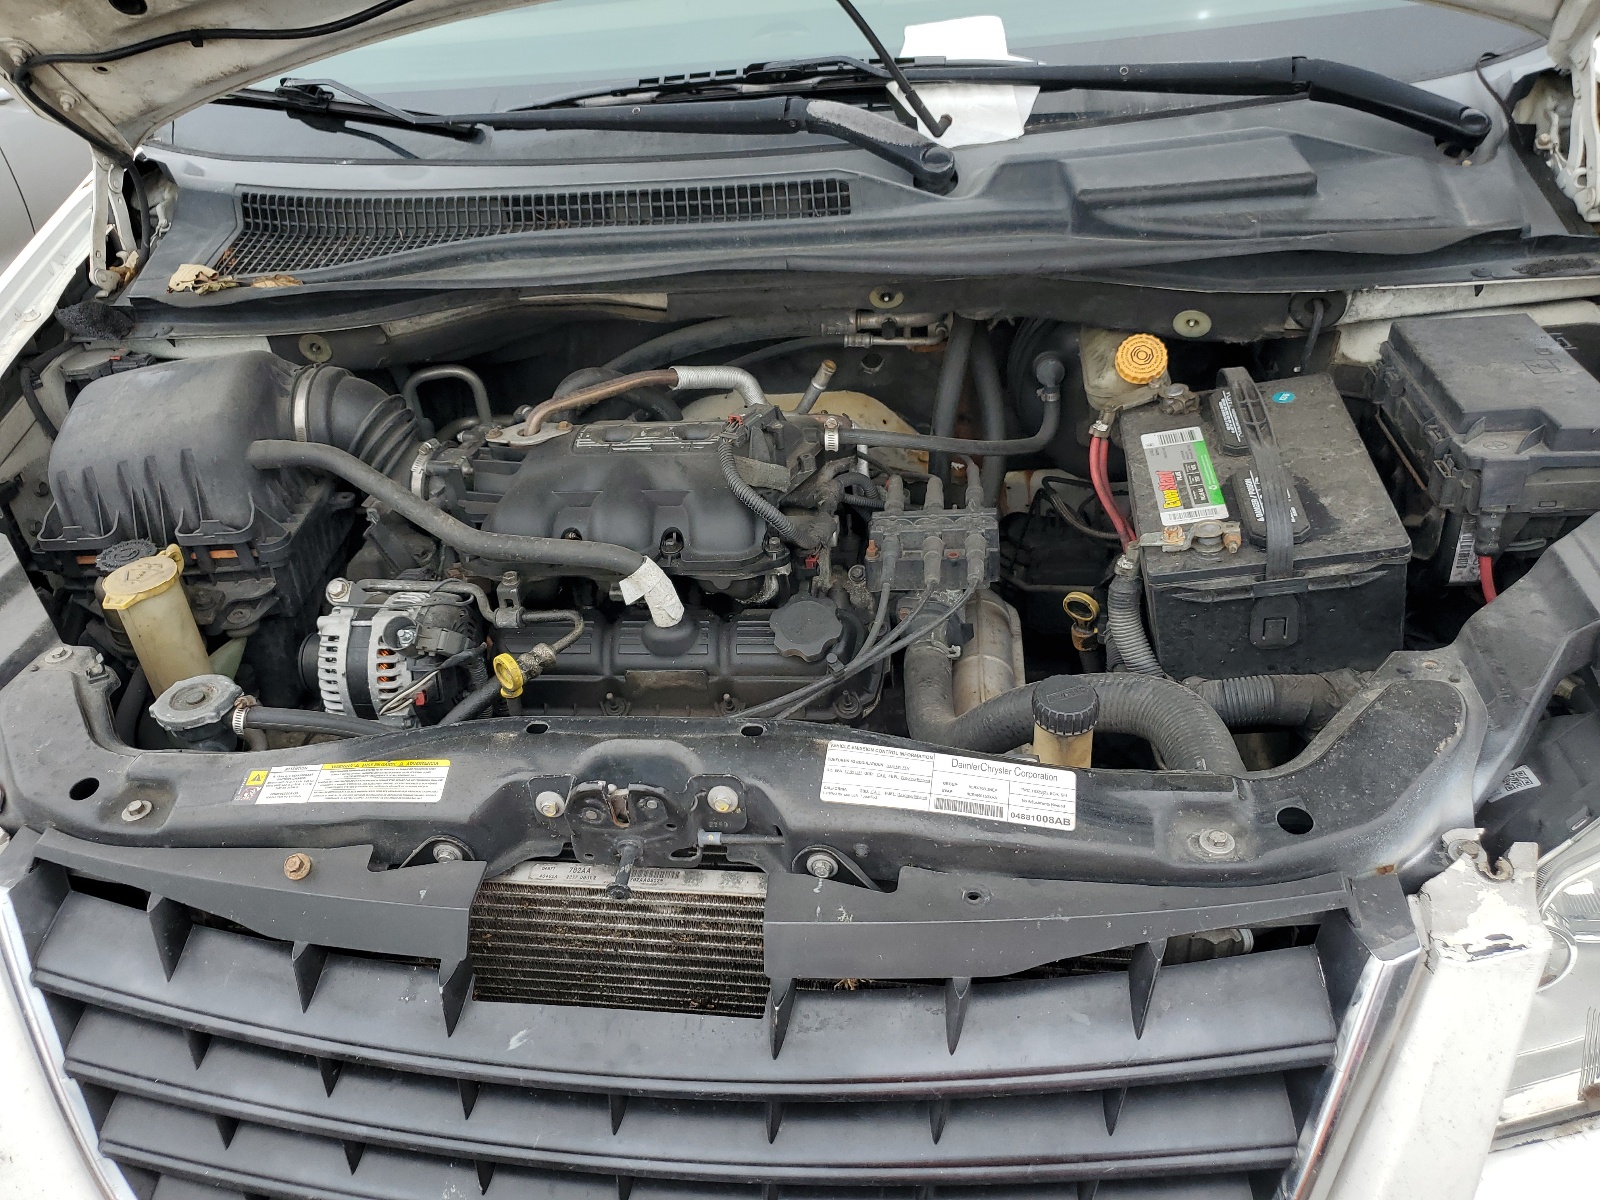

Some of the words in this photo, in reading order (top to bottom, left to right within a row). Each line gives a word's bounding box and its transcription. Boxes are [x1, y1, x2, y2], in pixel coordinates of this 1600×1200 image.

[1244, 478, 1256, 495] POISON
[1250, 498, 1264, 518] DANGER
[951, 758, 1012, 776] DaimlerChrysler
[1014, 767, 1058, 782] Corporation
